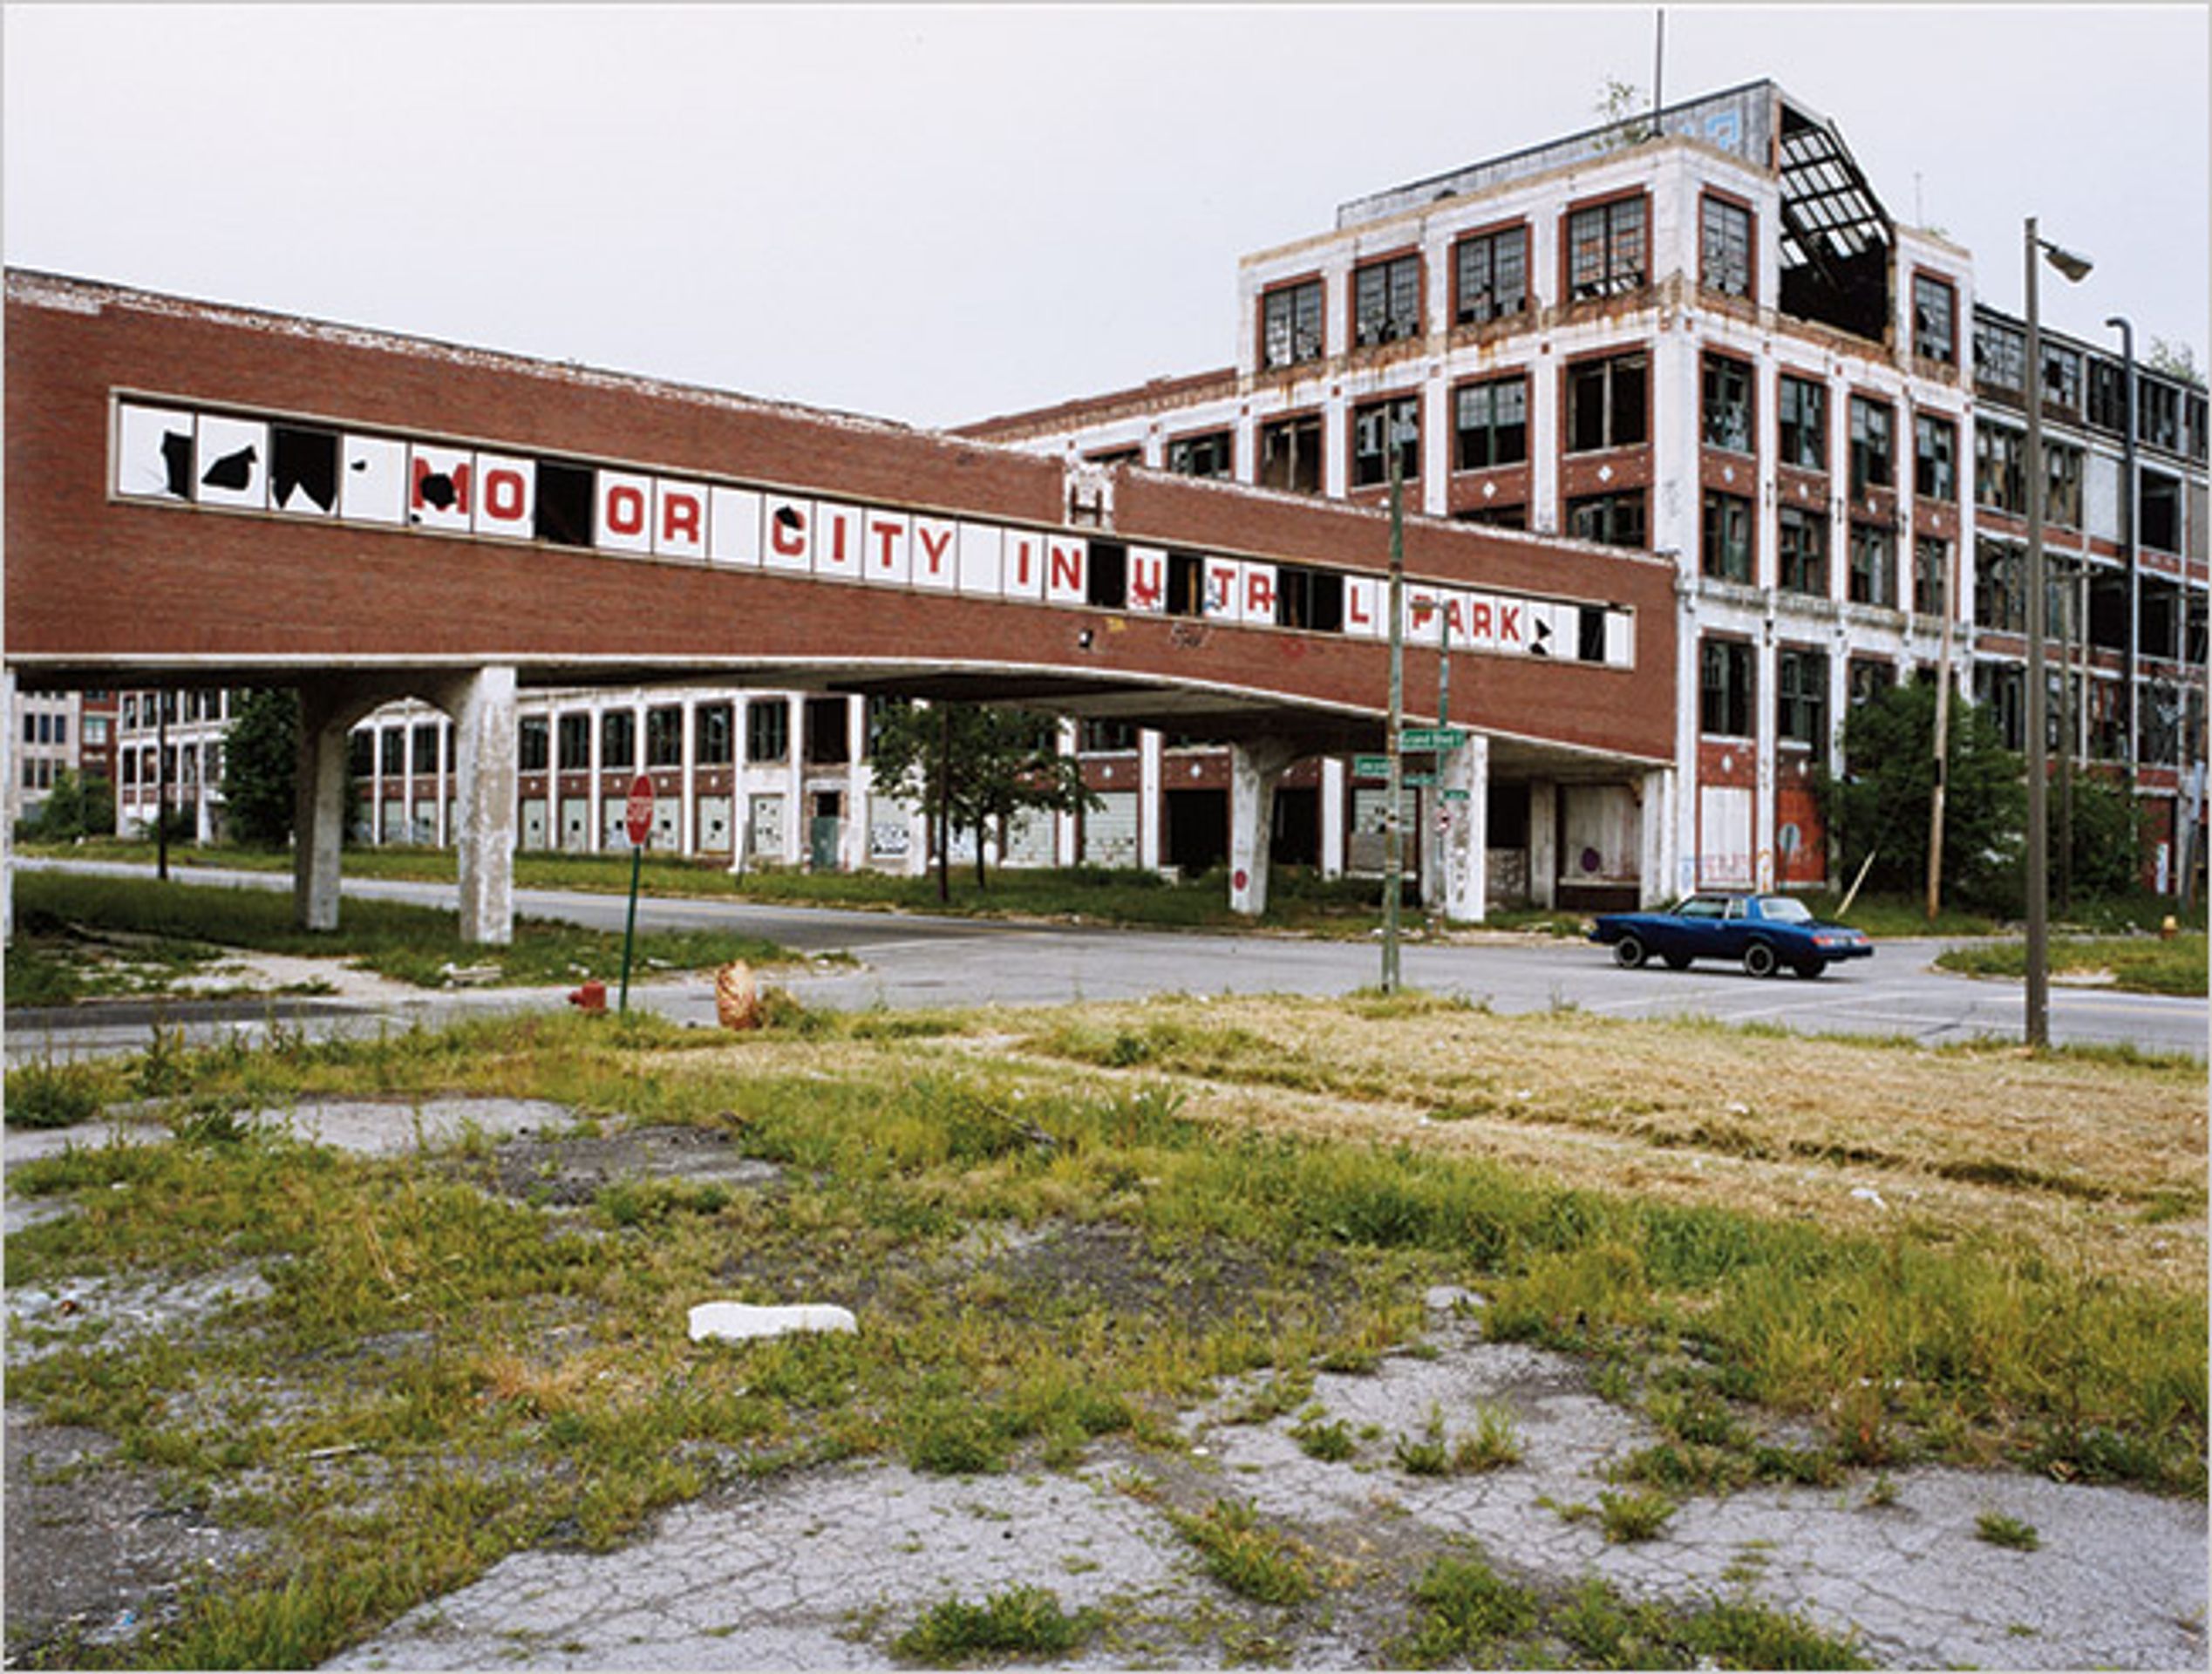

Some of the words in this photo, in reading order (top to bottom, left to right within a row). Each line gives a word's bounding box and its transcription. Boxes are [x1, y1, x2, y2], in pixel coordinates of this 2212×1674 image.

[412, 457, 700, 543] MOOR
[772, 507, 951, 573] CITY
[1409, 594, 1520, 642] PARK
